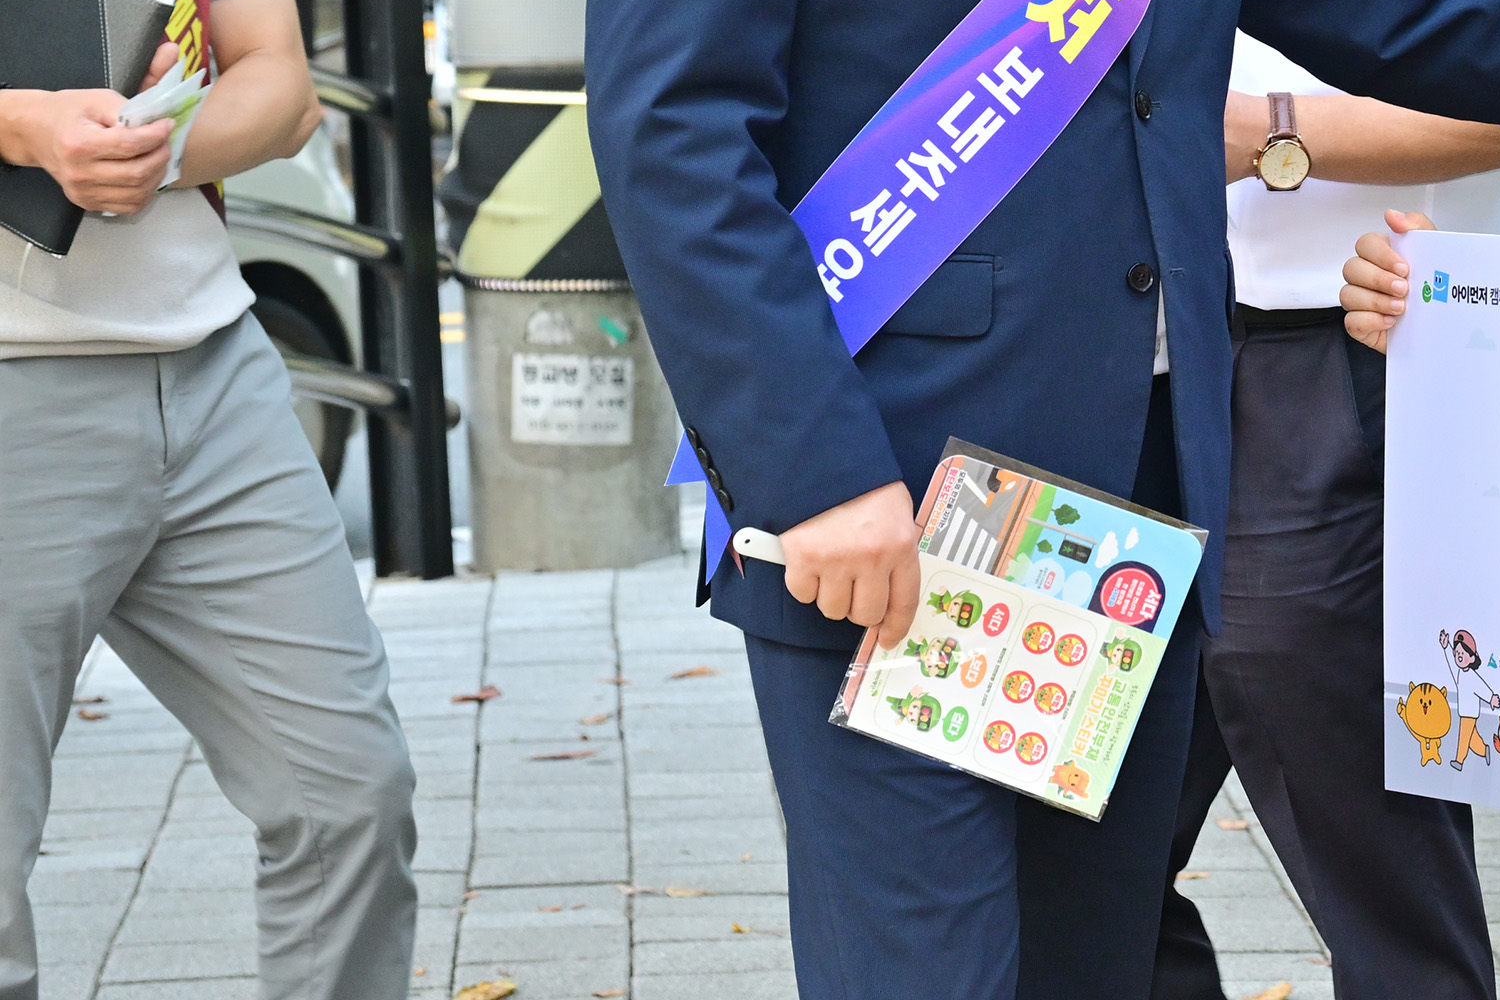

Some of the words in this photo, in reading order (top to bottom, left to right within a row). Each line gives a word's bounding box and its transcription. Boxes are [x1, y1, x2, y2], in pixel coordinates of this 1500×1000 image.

[818, 46, 1045, 304] 보내주세요
[1451, 283, 1488, 306] 아이먼저
[939, 468, 959, 502] 횡단보도
[925, 501, 945, 535] 안전보행
[938, 510, 950, 530] 지키는
[986, 606, 1006, 633] 서다
[1139, 588, 1162, 621] 서다
[964, 657, 983, 684] 보다
[1086, 673, 1114, 715] 꾸미기
[1070, 715, 1096, 756] 스티커
[1084, 679, 1128, 762] 교통안전부채
